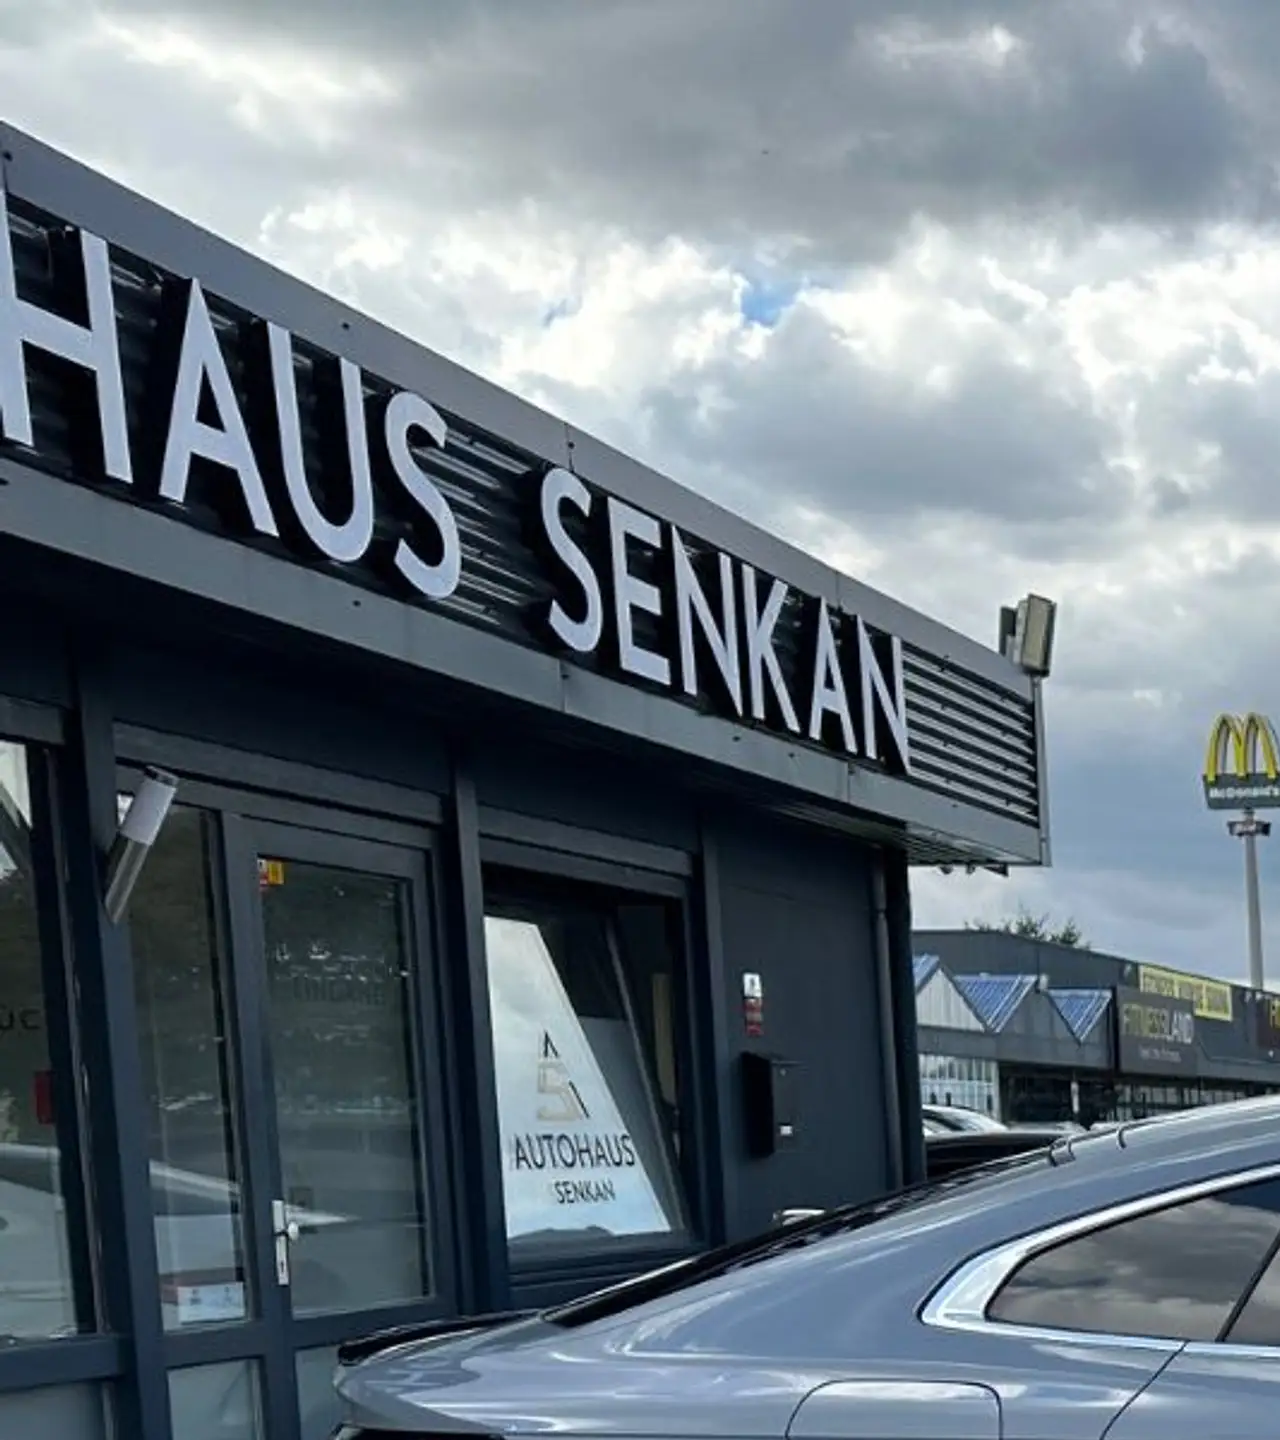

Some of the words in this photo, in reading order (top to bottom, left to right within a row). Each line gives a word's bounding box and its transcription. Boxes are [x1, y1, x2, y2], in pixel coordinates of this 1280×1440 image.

[540, 467, 909, 774] SENKAN
[514, 1133, 636, 1170] AUTOHAUS
[554, 1180, 617, 1204] SENKAN
